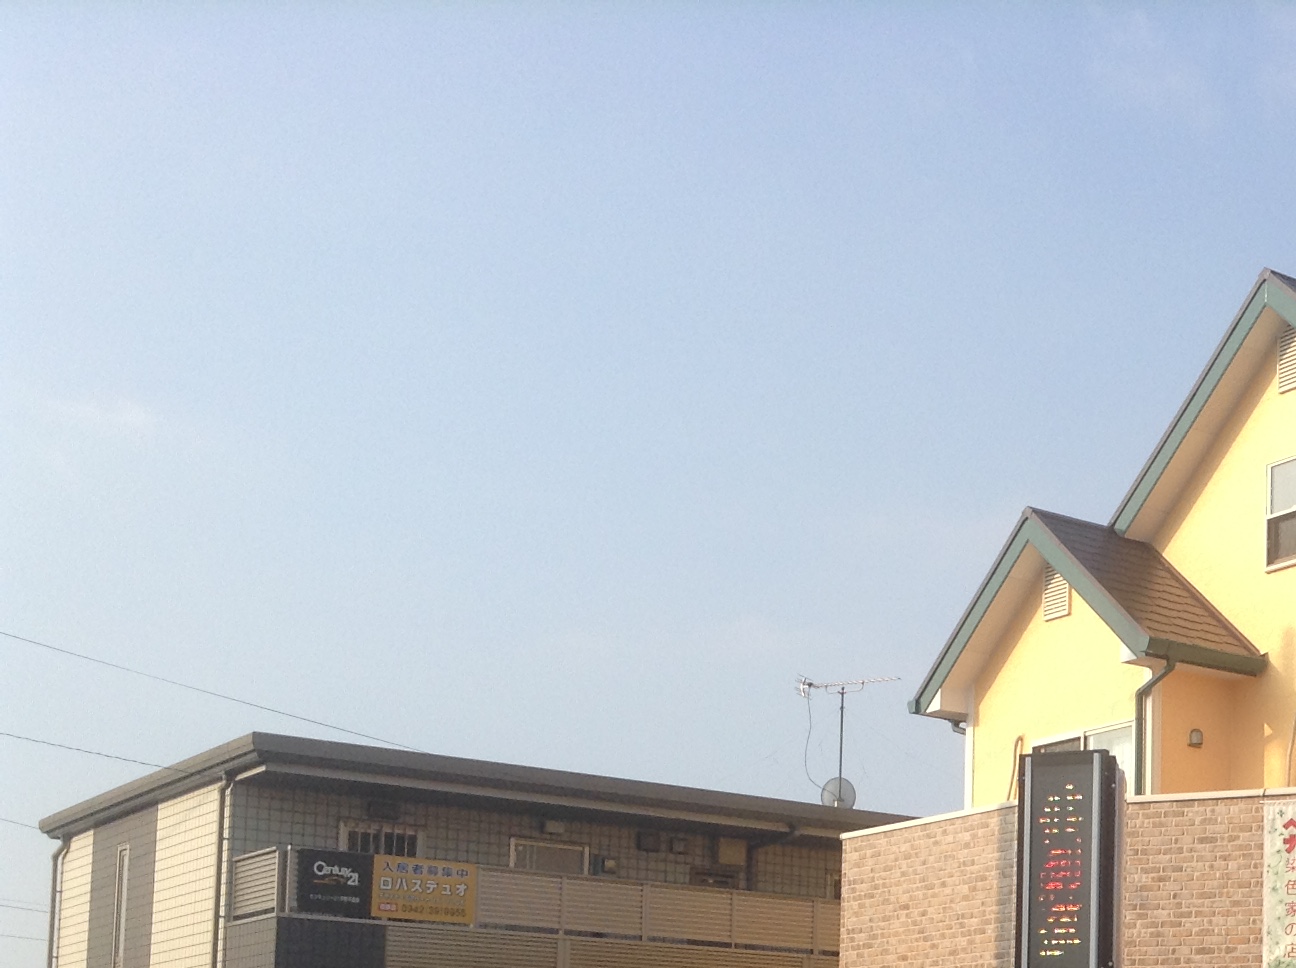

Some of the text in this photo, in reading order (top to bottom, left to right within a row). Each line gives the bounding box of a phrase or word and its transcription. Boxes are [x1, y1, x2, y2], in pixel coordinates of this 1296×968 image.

[313, 861, 352, 878] Century
[382, 861, 469, 879] 入居者募集中
